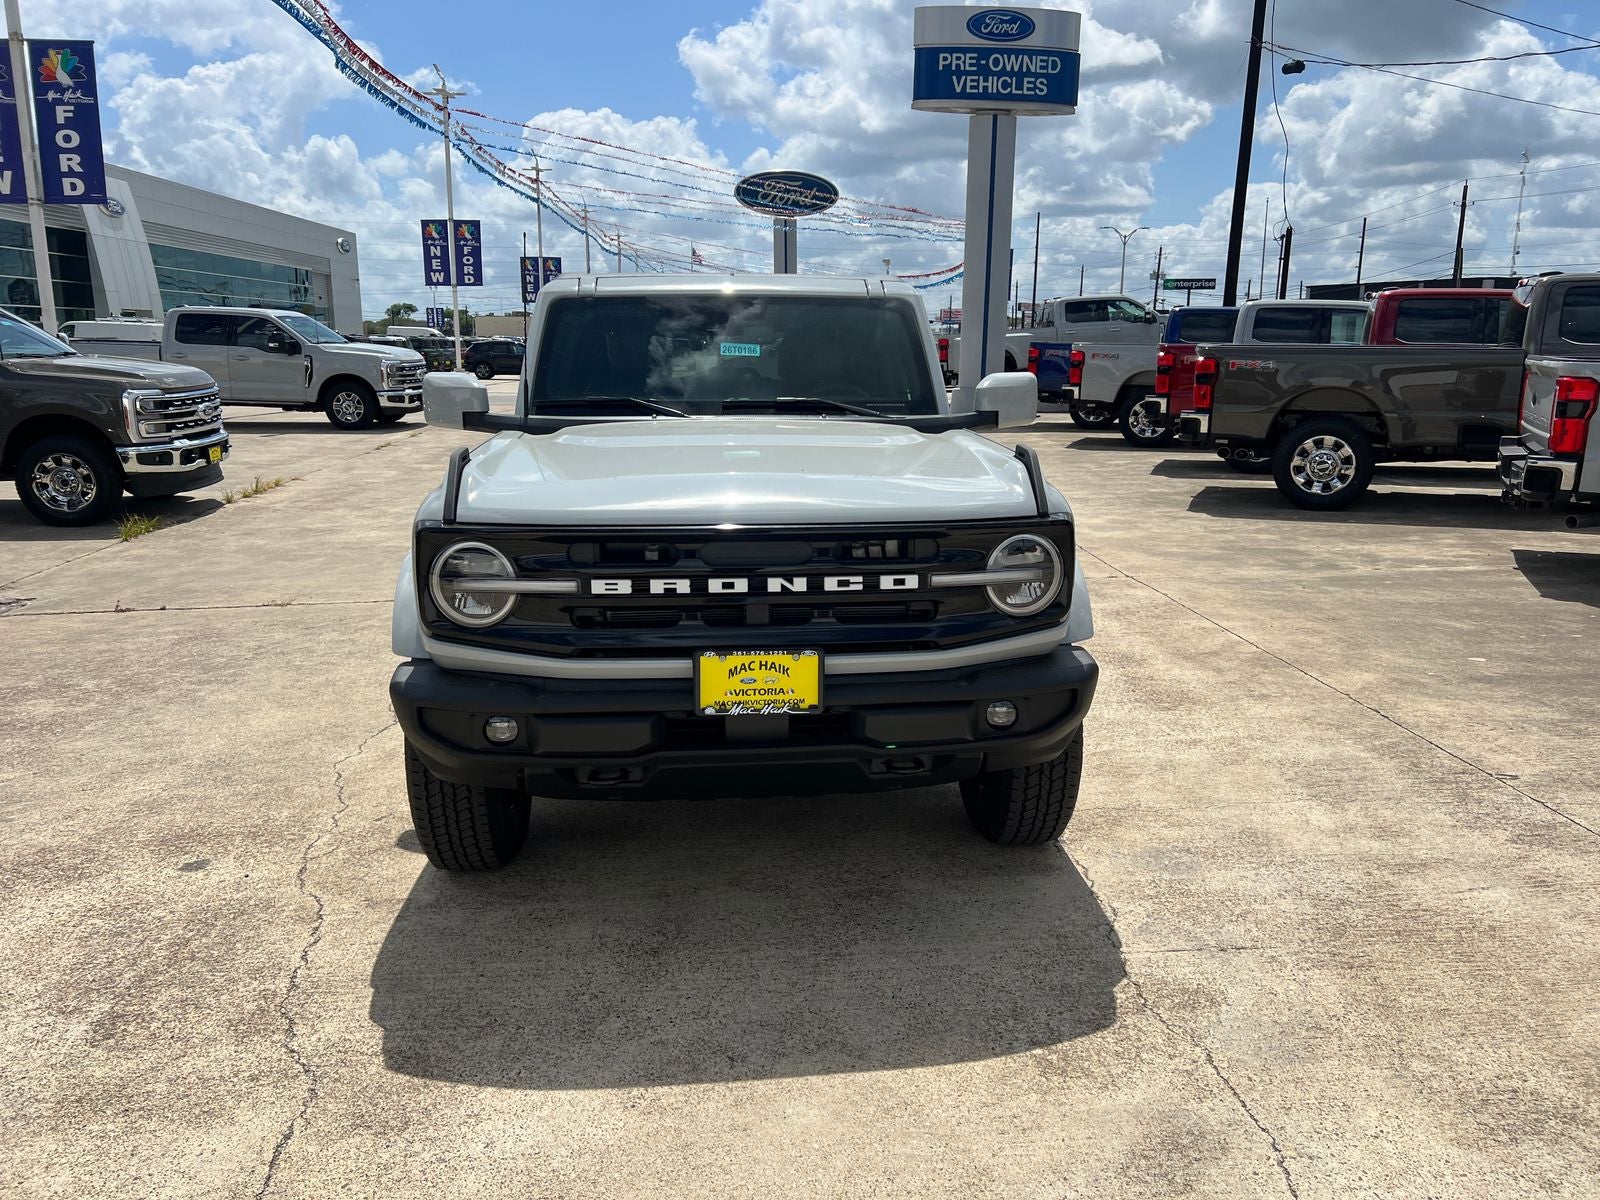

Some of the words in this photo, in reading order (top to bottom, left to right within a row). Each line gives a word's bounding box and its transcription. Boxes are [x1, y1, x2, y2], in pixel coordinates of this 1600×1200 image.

[981, 14, 1020, 34] Ford
[952, 75, 1048, 96] VEHICLES
[54, 105, 86, 197] FORD
[430, 245, 445, 283] NEW
[462, 246, 475, 284] FORD
[525, 274, 537, 301] NEW
[1165, 279, 1216, 289] enterprise
[722, 345, 758, 355] 26T0186
[1229, 359, 1273, 371] FX4
[590, 573, 919, 595] BRONCO
[728, 660, 756, 680] MAC
[758, 660, 791, 678] HAIK
[733, 687, 786, 697] VICTORIA
[728, 703, 759, 716] Mac
[760, 702, 792, 715] Haik
